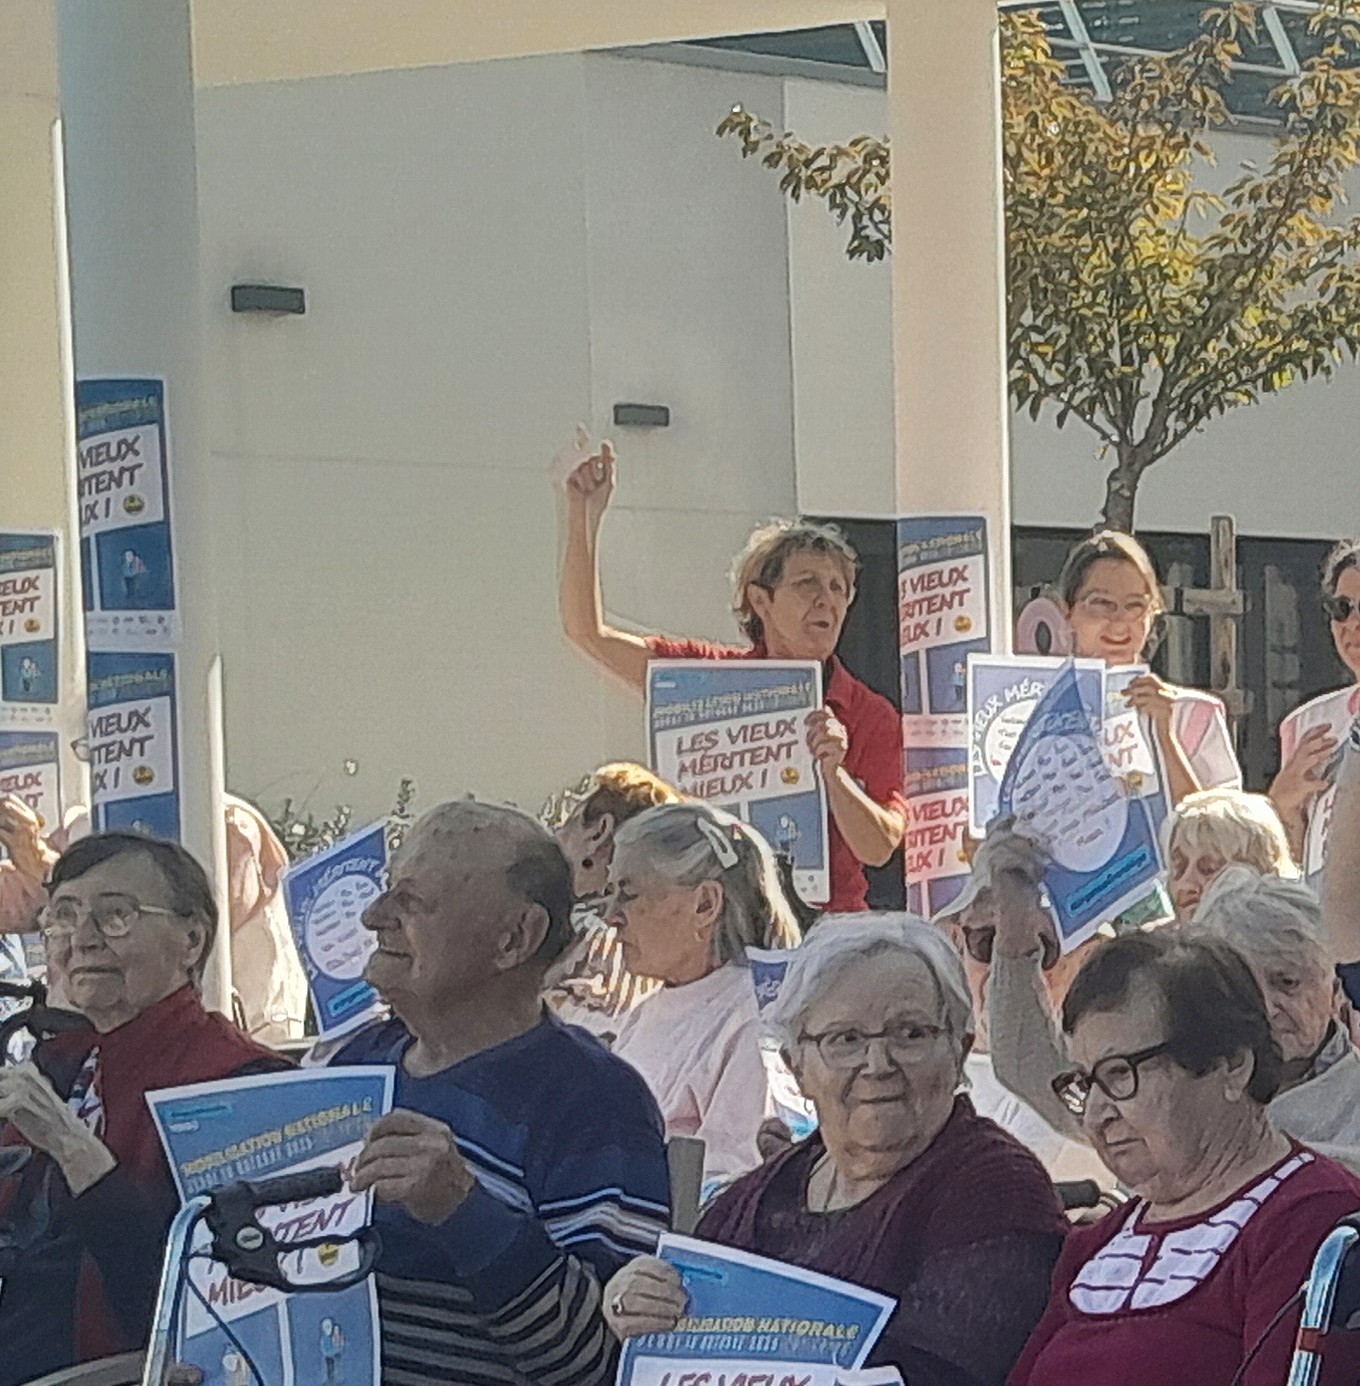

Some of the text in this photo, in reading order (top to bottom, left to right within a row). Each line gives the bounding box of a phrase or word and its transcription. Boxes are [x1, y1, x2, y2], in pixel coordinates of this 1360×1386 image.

[910, 564, 969, 594] VIEUX
[93, 735, 154, 763] TENT
[676, 716, 797, 755] LES VIEUX
